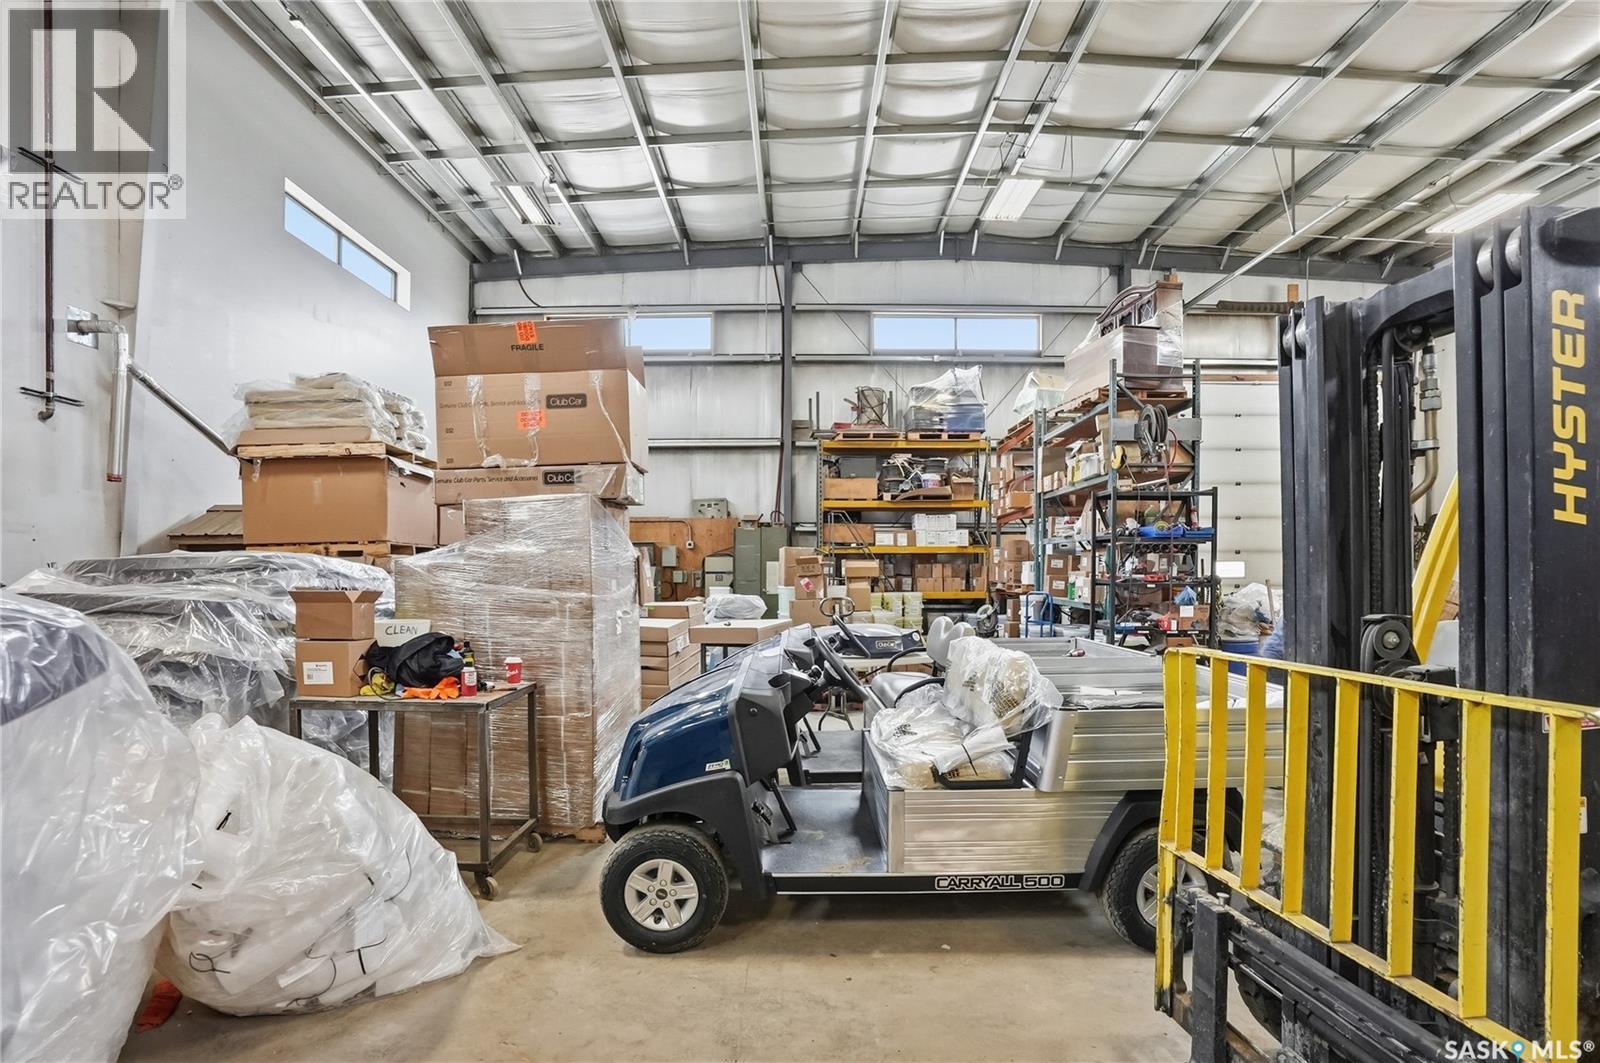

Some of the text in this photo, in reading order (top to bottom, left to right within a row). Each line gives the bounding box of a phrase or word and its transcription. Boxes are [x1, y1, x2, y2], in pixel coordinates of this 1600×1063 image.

[510, 344, 545, 352] FRAGILE
[1551, 289, 1588, 526] HYSTER
[384, 624, 418, 636] CLEAN
[935, 874, 1066, 891] CARRYALL 500
